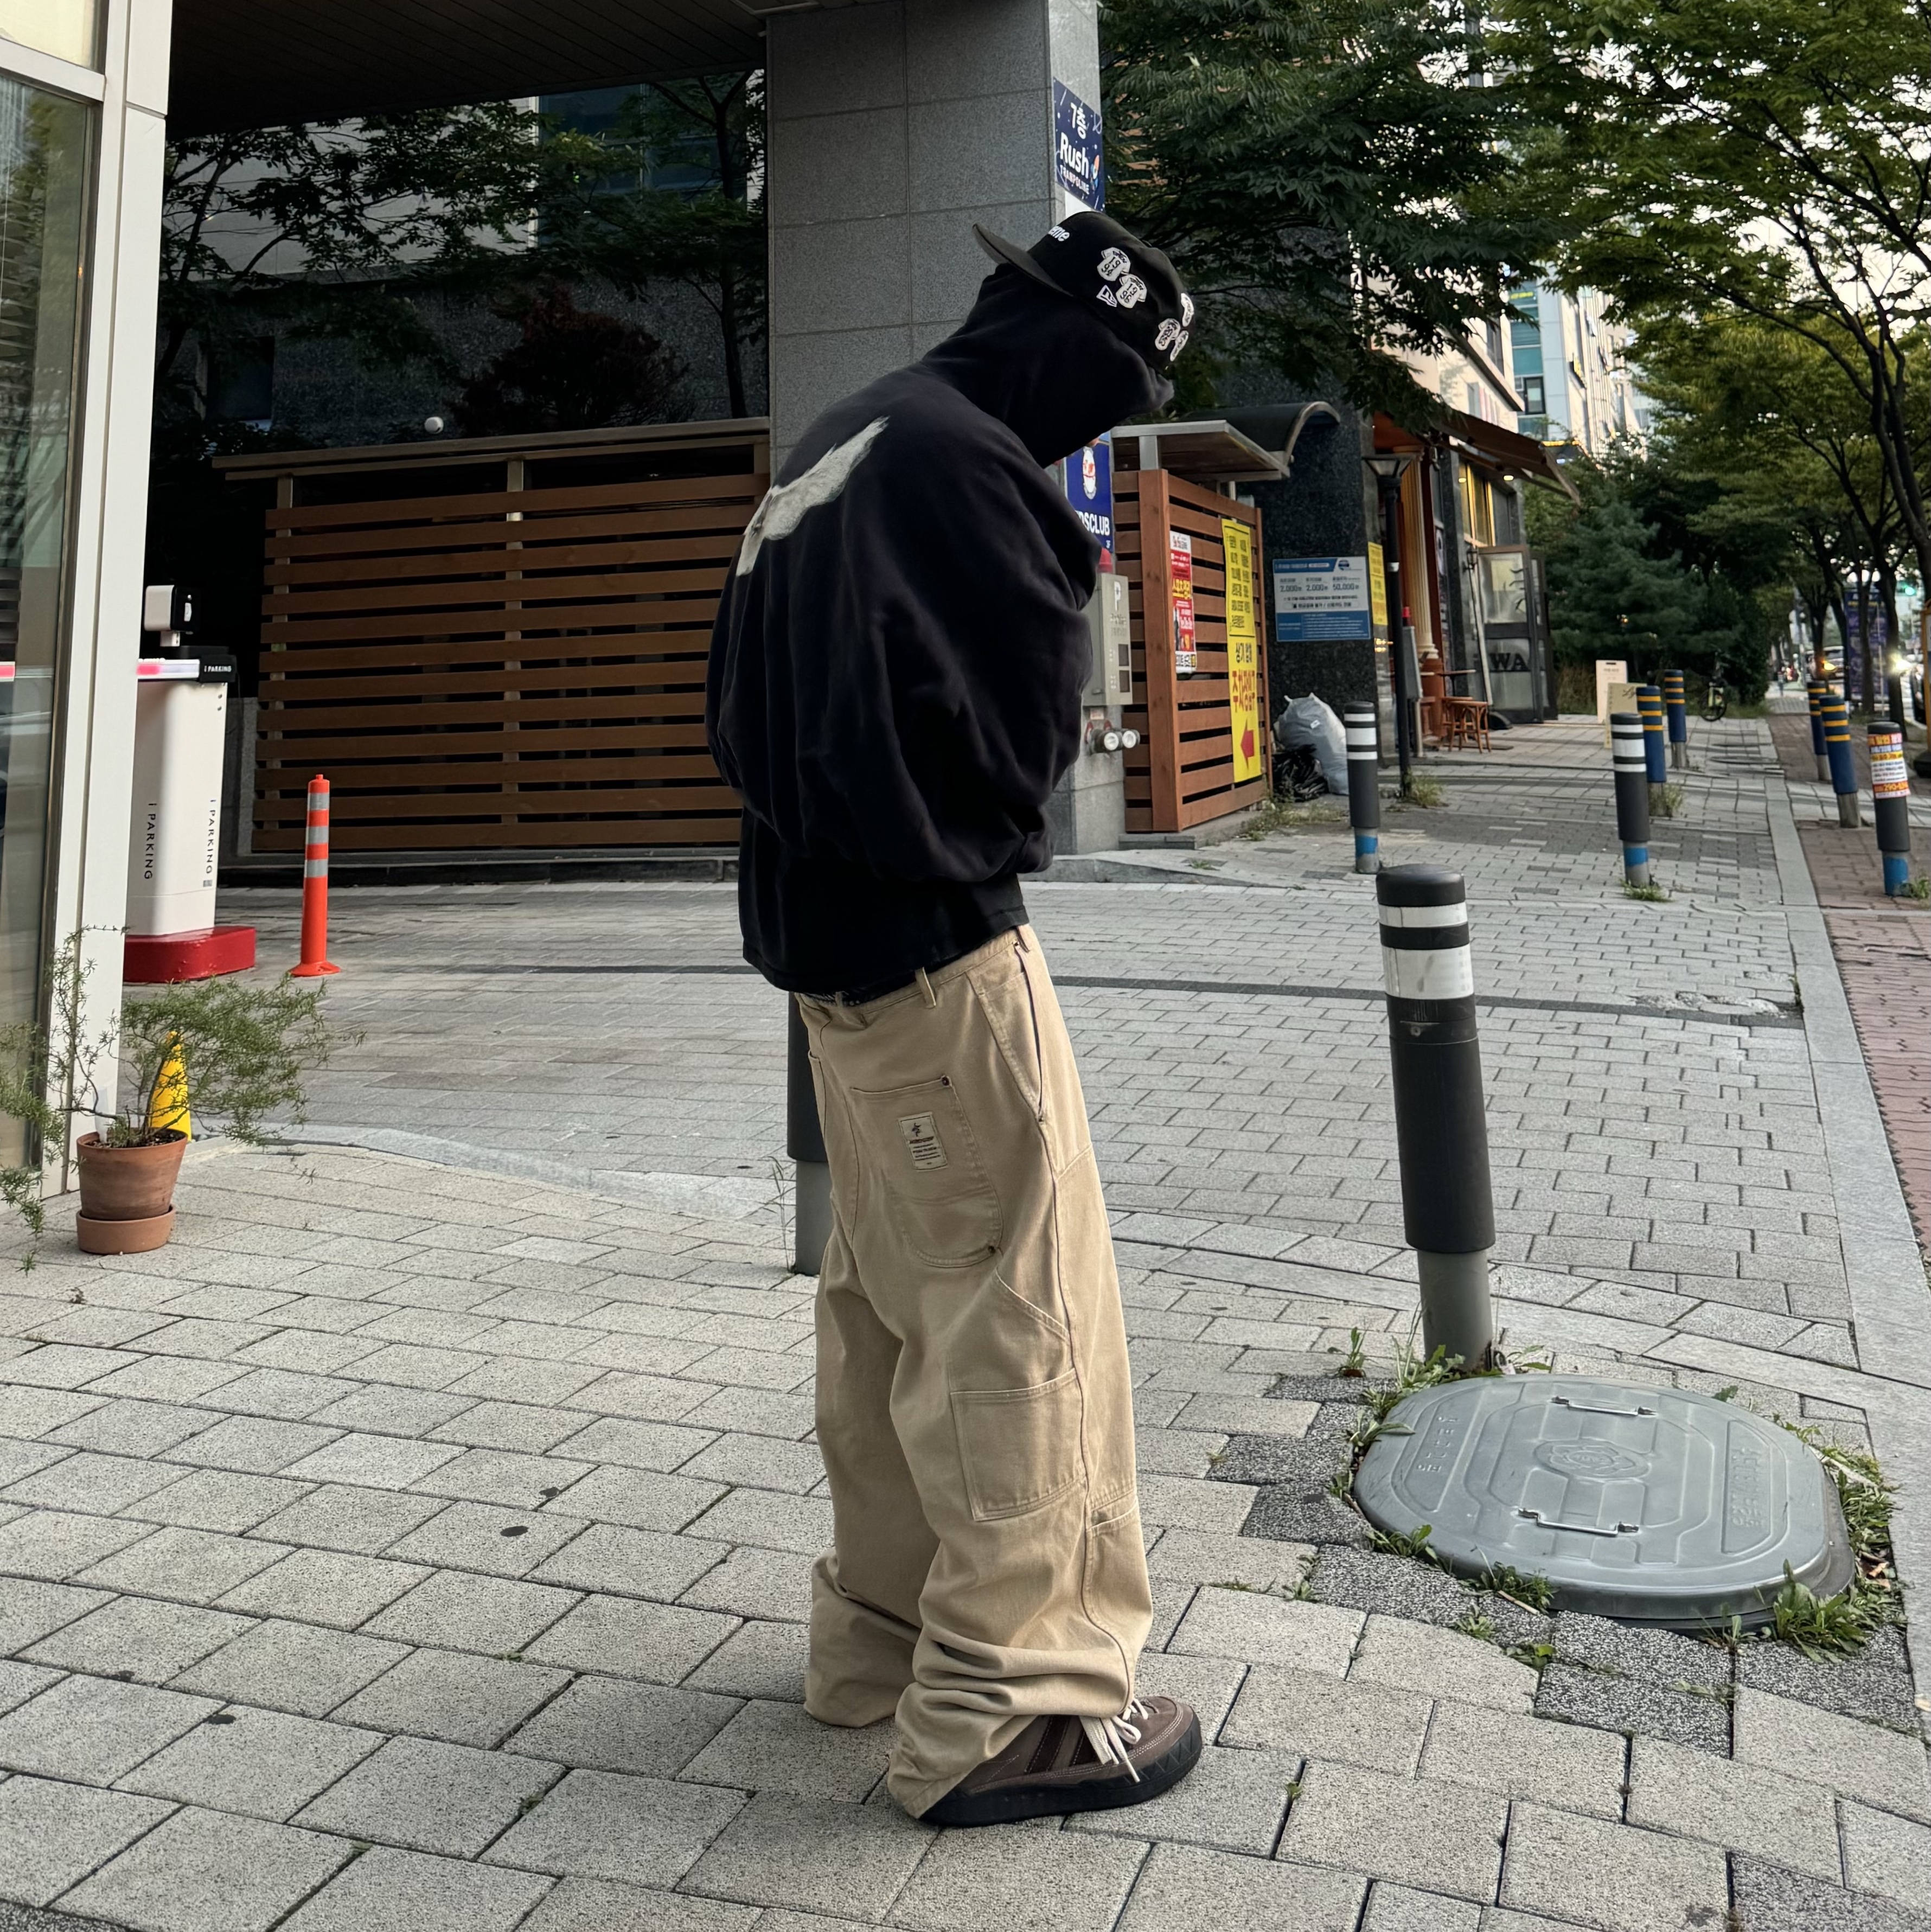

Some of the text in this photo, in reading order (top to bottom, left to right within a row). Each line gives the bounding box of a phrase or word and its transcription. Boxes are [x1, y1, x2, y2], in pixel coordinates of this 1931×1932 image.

[1060, 132, 1089, 179] Rush
[144, 814, 156, 879] PARKING
[206, 810, 216, 874] PARKING
